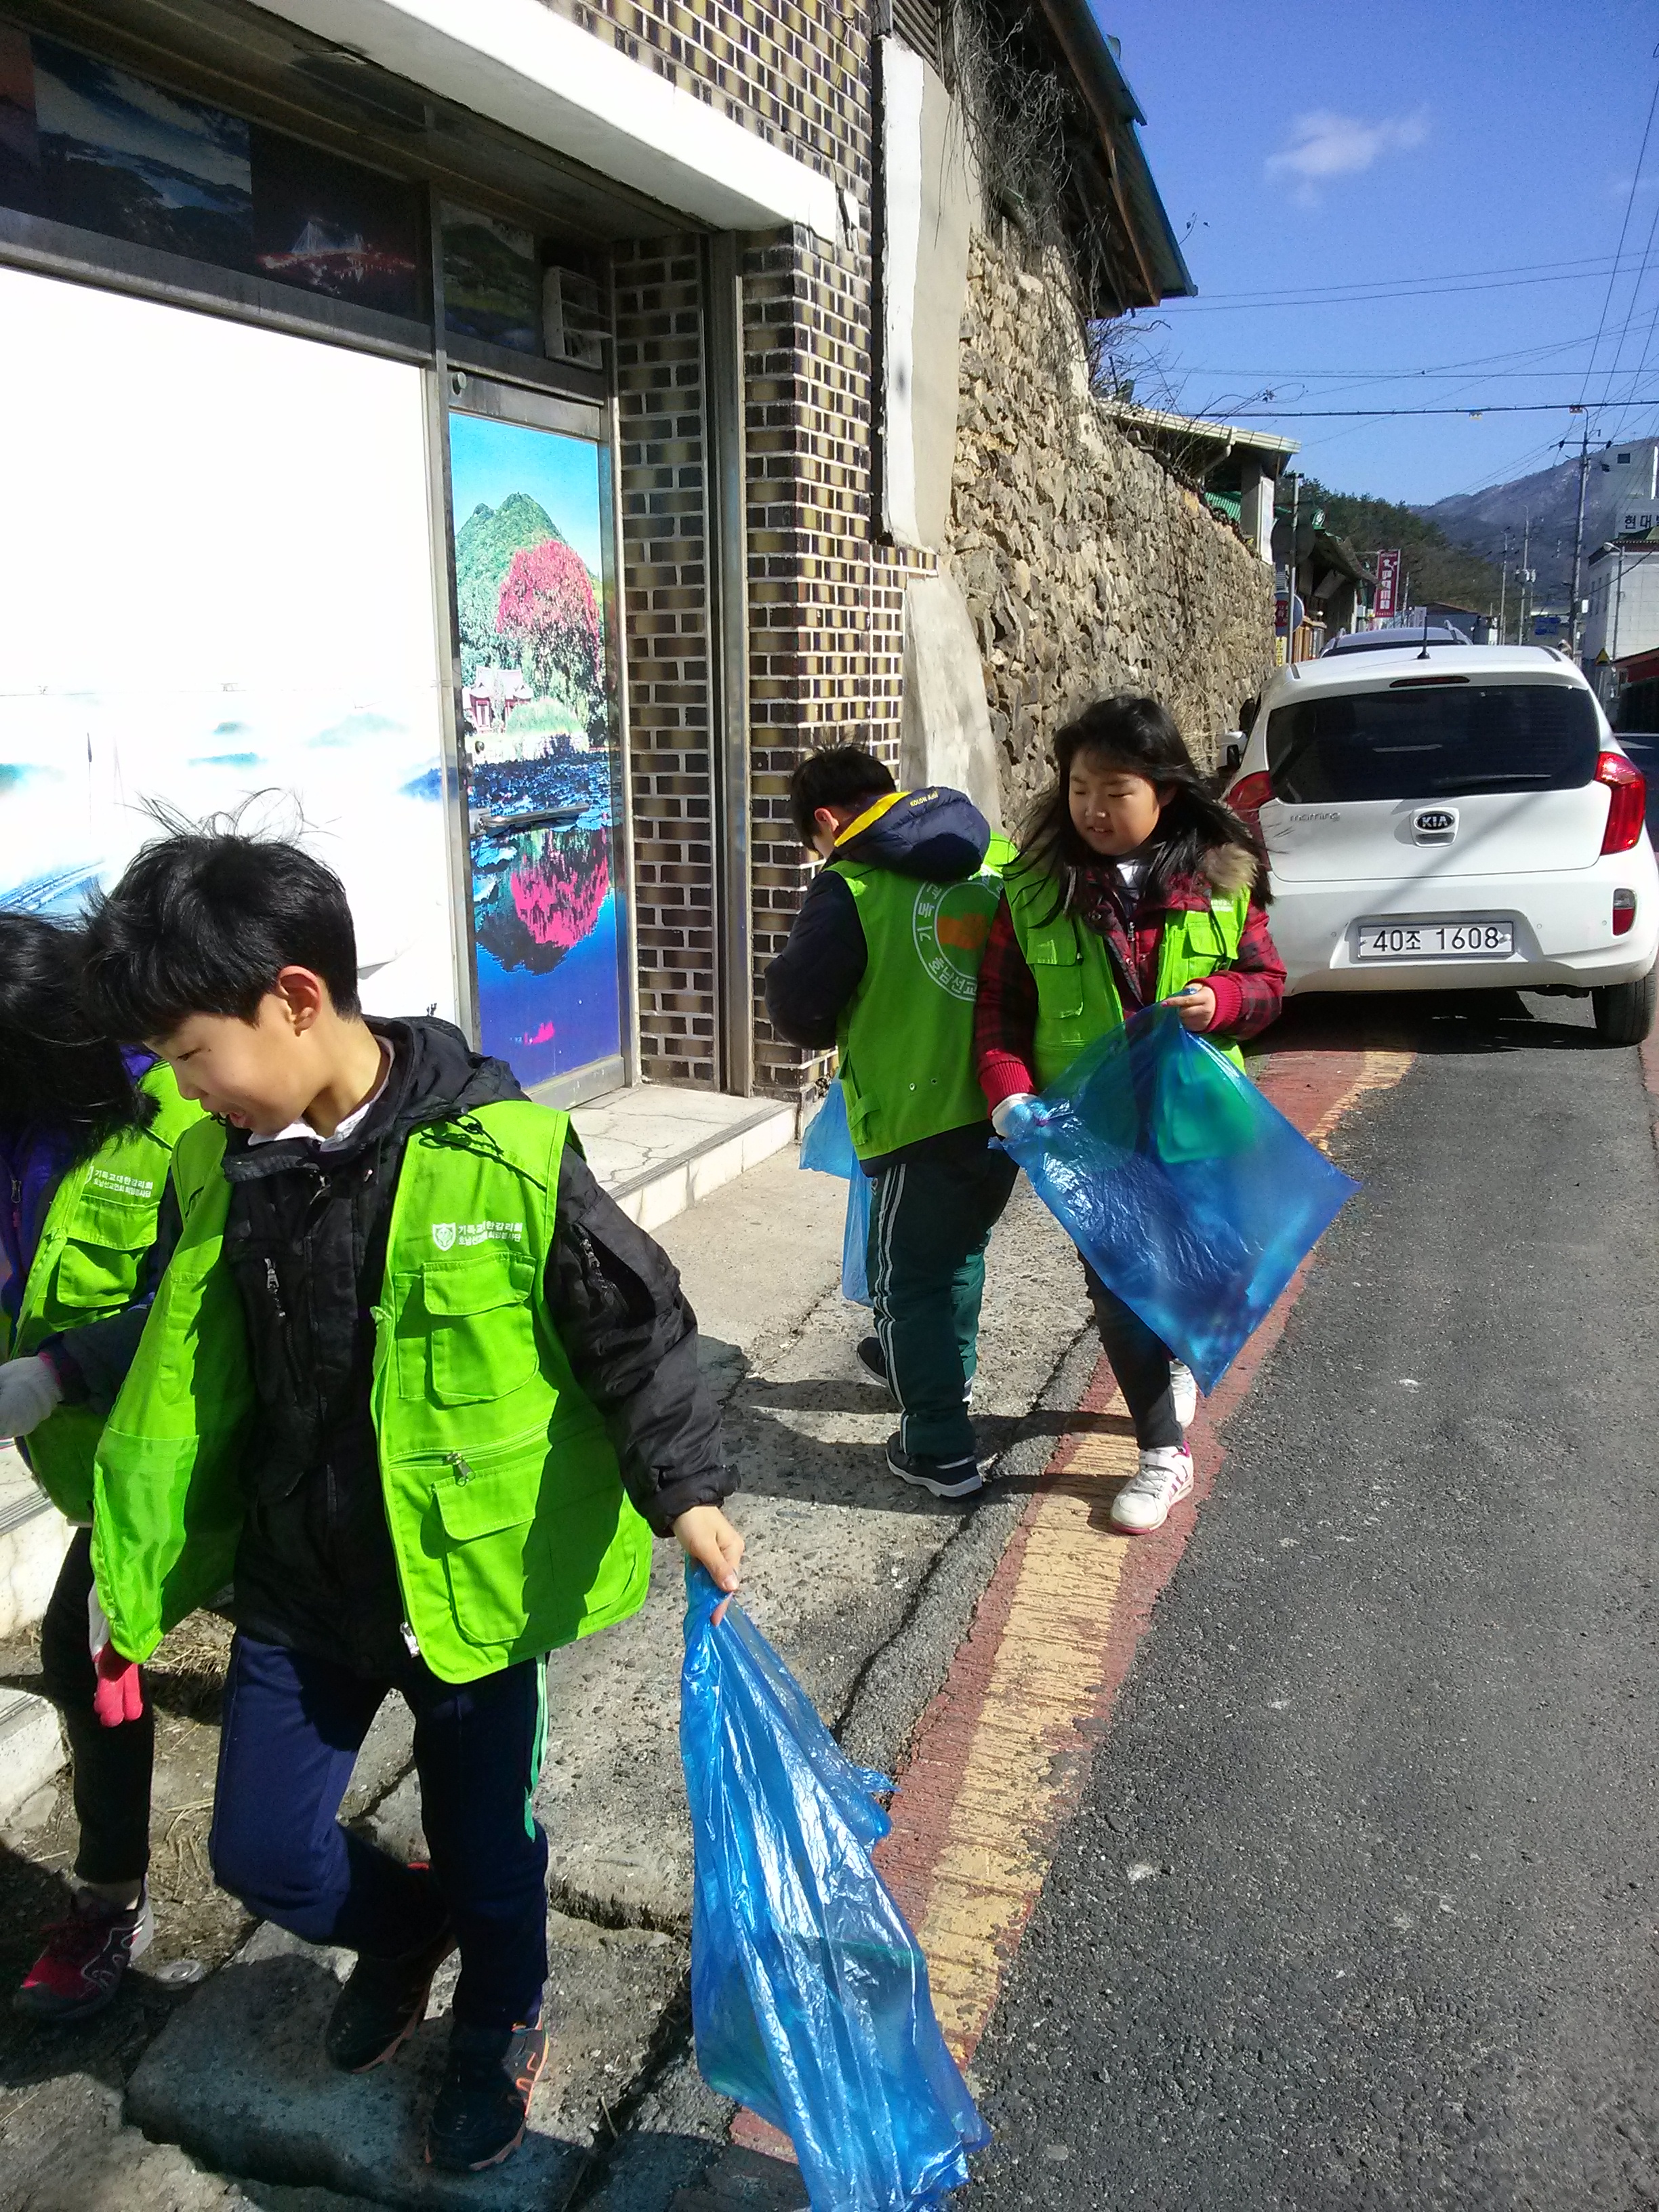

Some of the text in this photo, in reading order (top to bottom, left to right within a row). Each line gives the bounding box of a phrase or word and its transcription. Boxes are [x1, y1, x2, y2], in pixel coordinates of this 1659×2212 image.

[1624, 515, 1659, 529] 현대
[1290, 812, 1340, 821] morning
[1422, 816, 1448, 827] KIA
[1372, 926, 1499, 951] 40조 1608
[94, 1170, 153, 1190] 기독교대한감리회
